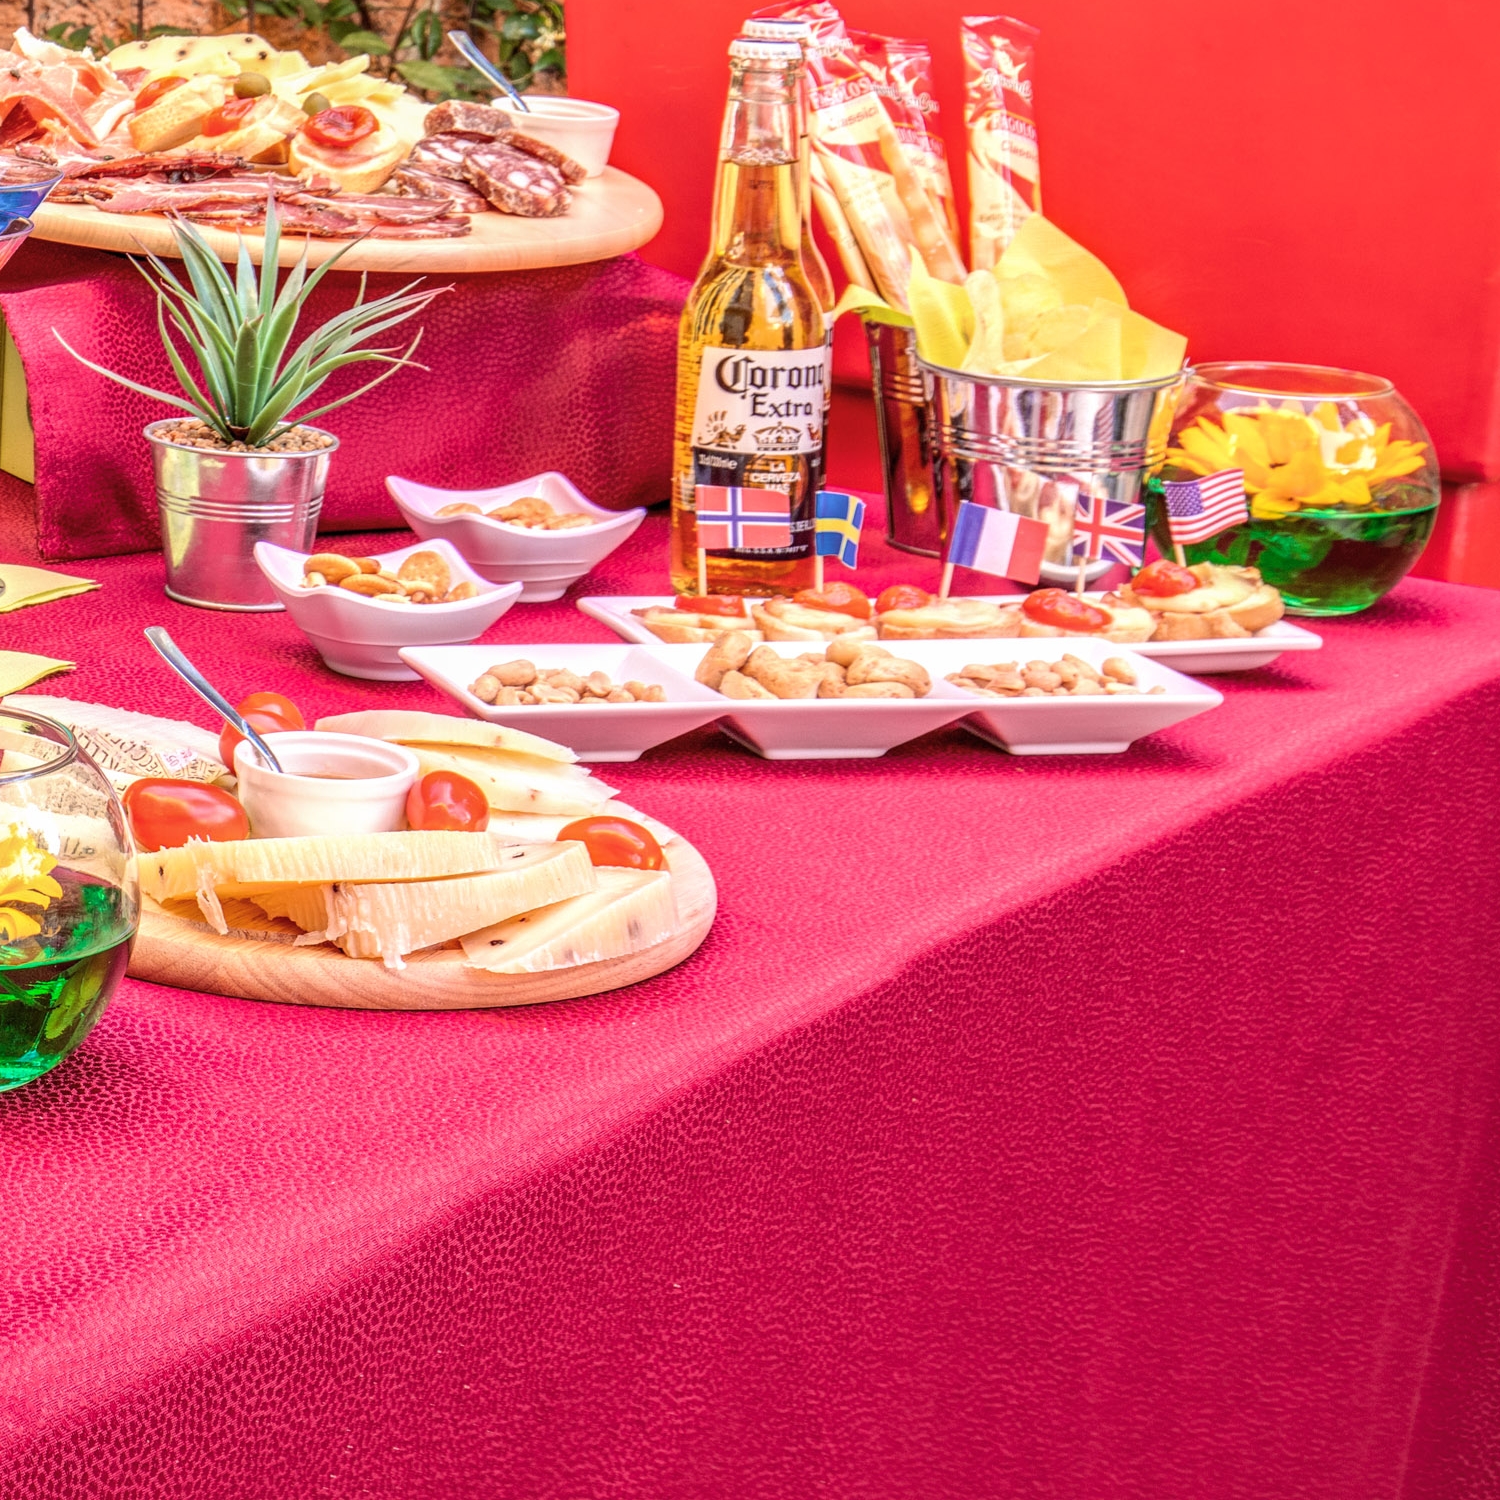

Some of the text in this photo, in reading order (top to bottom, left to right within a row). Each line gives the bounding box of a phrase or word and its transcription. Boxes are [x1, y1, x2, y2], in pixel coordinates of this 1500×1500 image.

[750, 392, 813, 418] Extra
[769, 461, 786, 472] LA
[749, 471, 801, 483] CERVEZA
